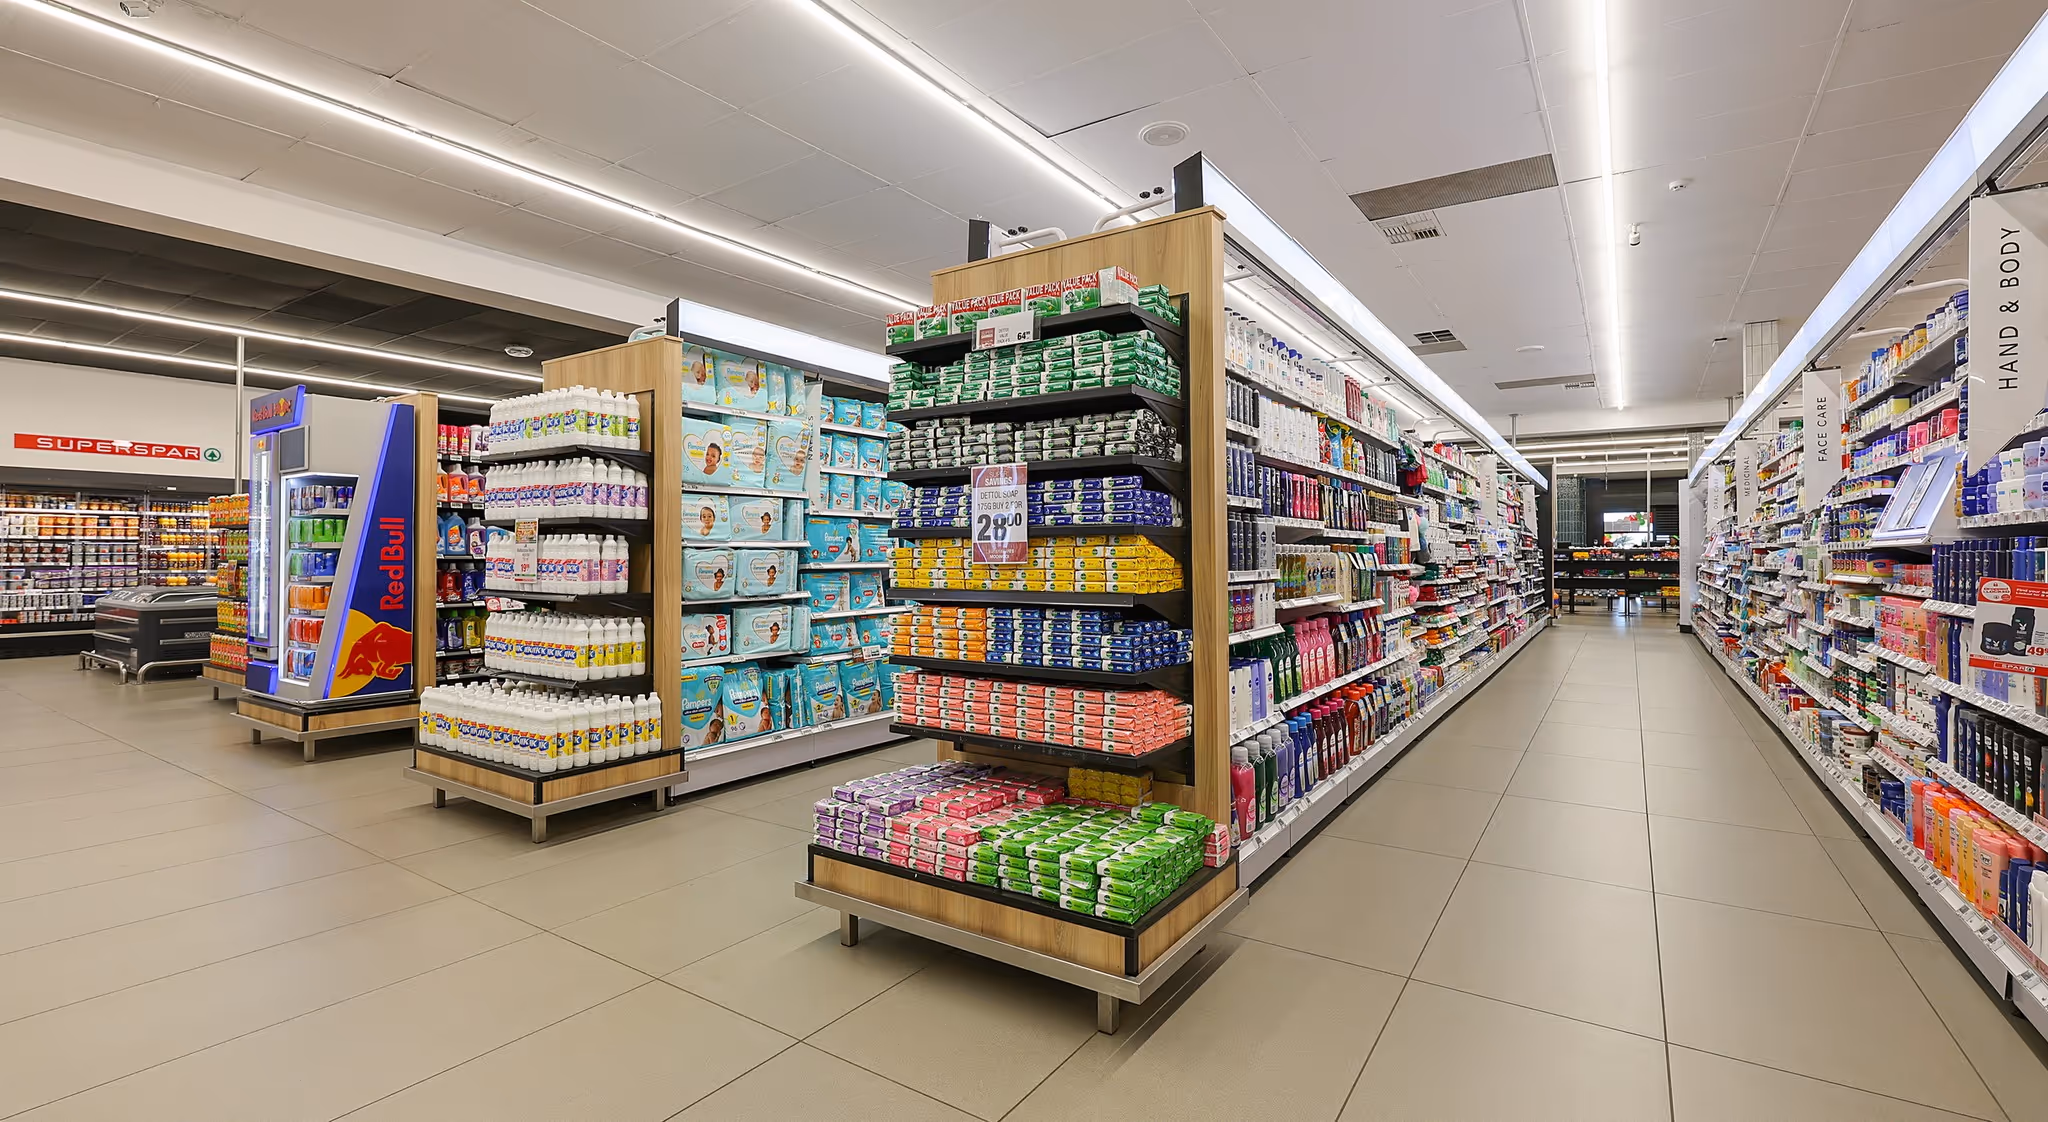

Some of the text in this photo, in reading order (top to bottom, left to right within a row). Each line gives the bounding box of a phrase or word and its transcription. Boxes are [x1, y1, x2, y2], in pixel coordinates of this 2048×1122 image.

[1062, 272, 1097, 288] VALUE PACK
[1026, 282, 1061, 296] VALUE PACK
[988, 290, 1021, 306] VALUE PACK
[952, 300, 970, 312] VALUE
[1998, 228, 2020, 390] HAND & BODY
[1817, 396, 1828, 462] FACE CARE
[36, 437, 199, 459] SUPERSPAR
[985, 477, 1012, 486] SAVINGS
[980, 490, 1018, 500] DETTOL SOAP
[978, 502, 991, 511] 175G
[379, 517, 405, 610] Red Bull
[2002, 662, 2025, 671] SPAR
[729, 688, 759, 700] Pampers
[682, 698, 712, 710] Pampers
